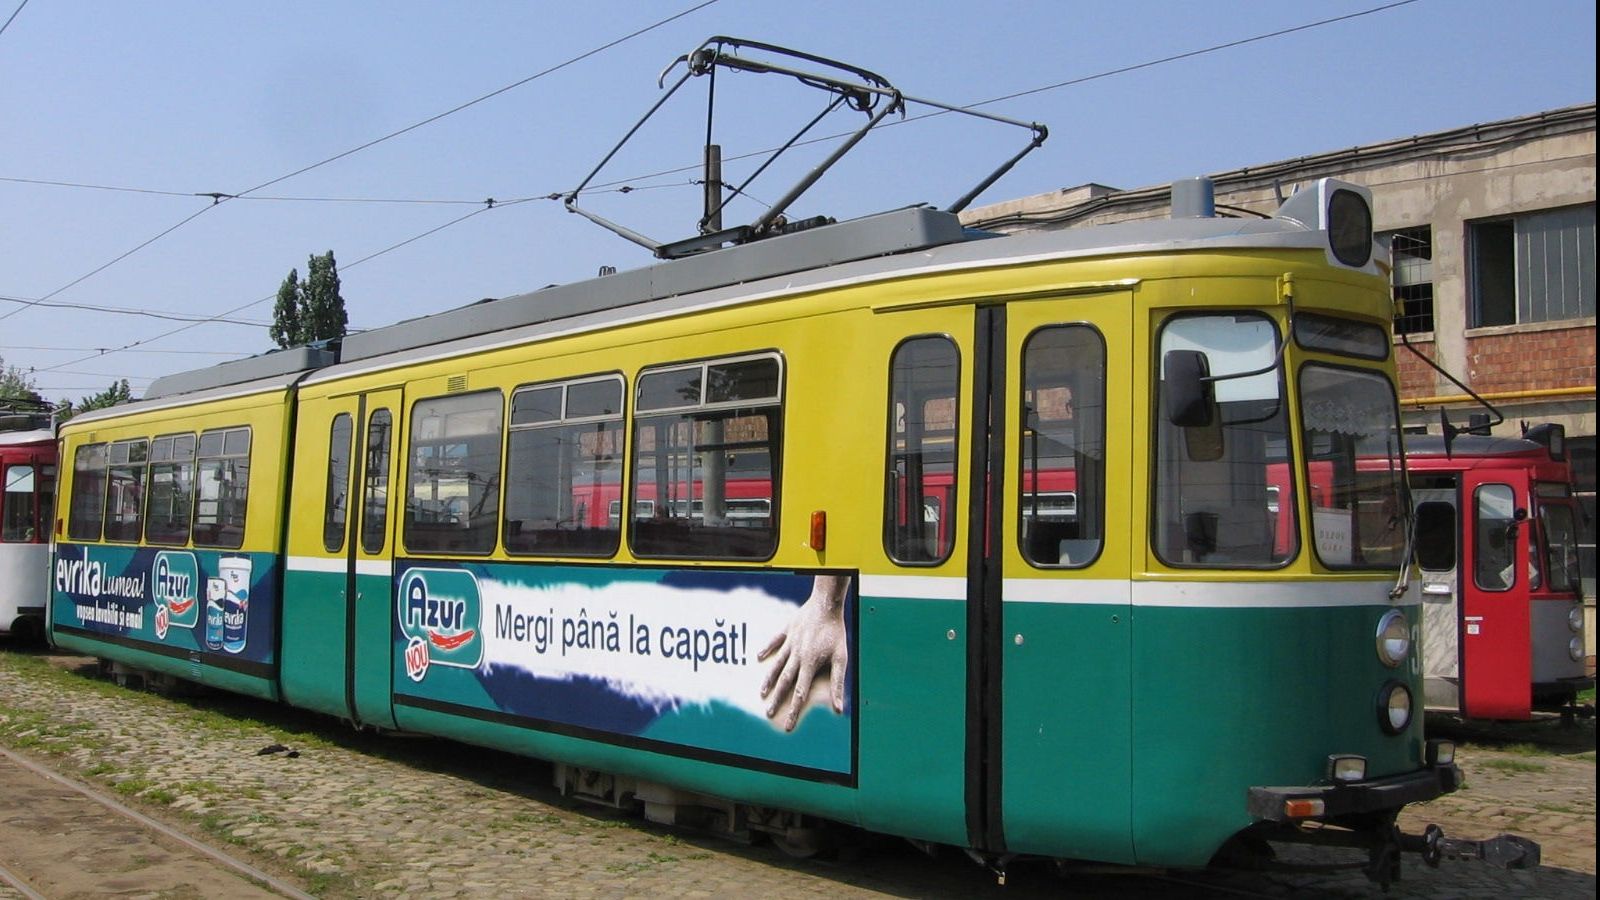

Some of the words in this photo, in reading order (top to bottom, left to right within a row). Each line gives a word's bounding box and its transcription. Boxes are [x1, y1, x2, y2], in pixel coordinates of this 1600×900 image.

[56, 546, 101, 597] evrika
[101, 562, 145, 599] Lumea!
[157, 556, 189, 599] Azur
[76, 604, 95, 626] vopsea
[407, 576, 464, 630] Azur
[407, 644, 428, 673] NOU
[495, 603, 554, 655] Mergi
[562, 607, 621, 657] până
[629, 613, 651, 656] la
[659, 617, 747, 672] capăt!
